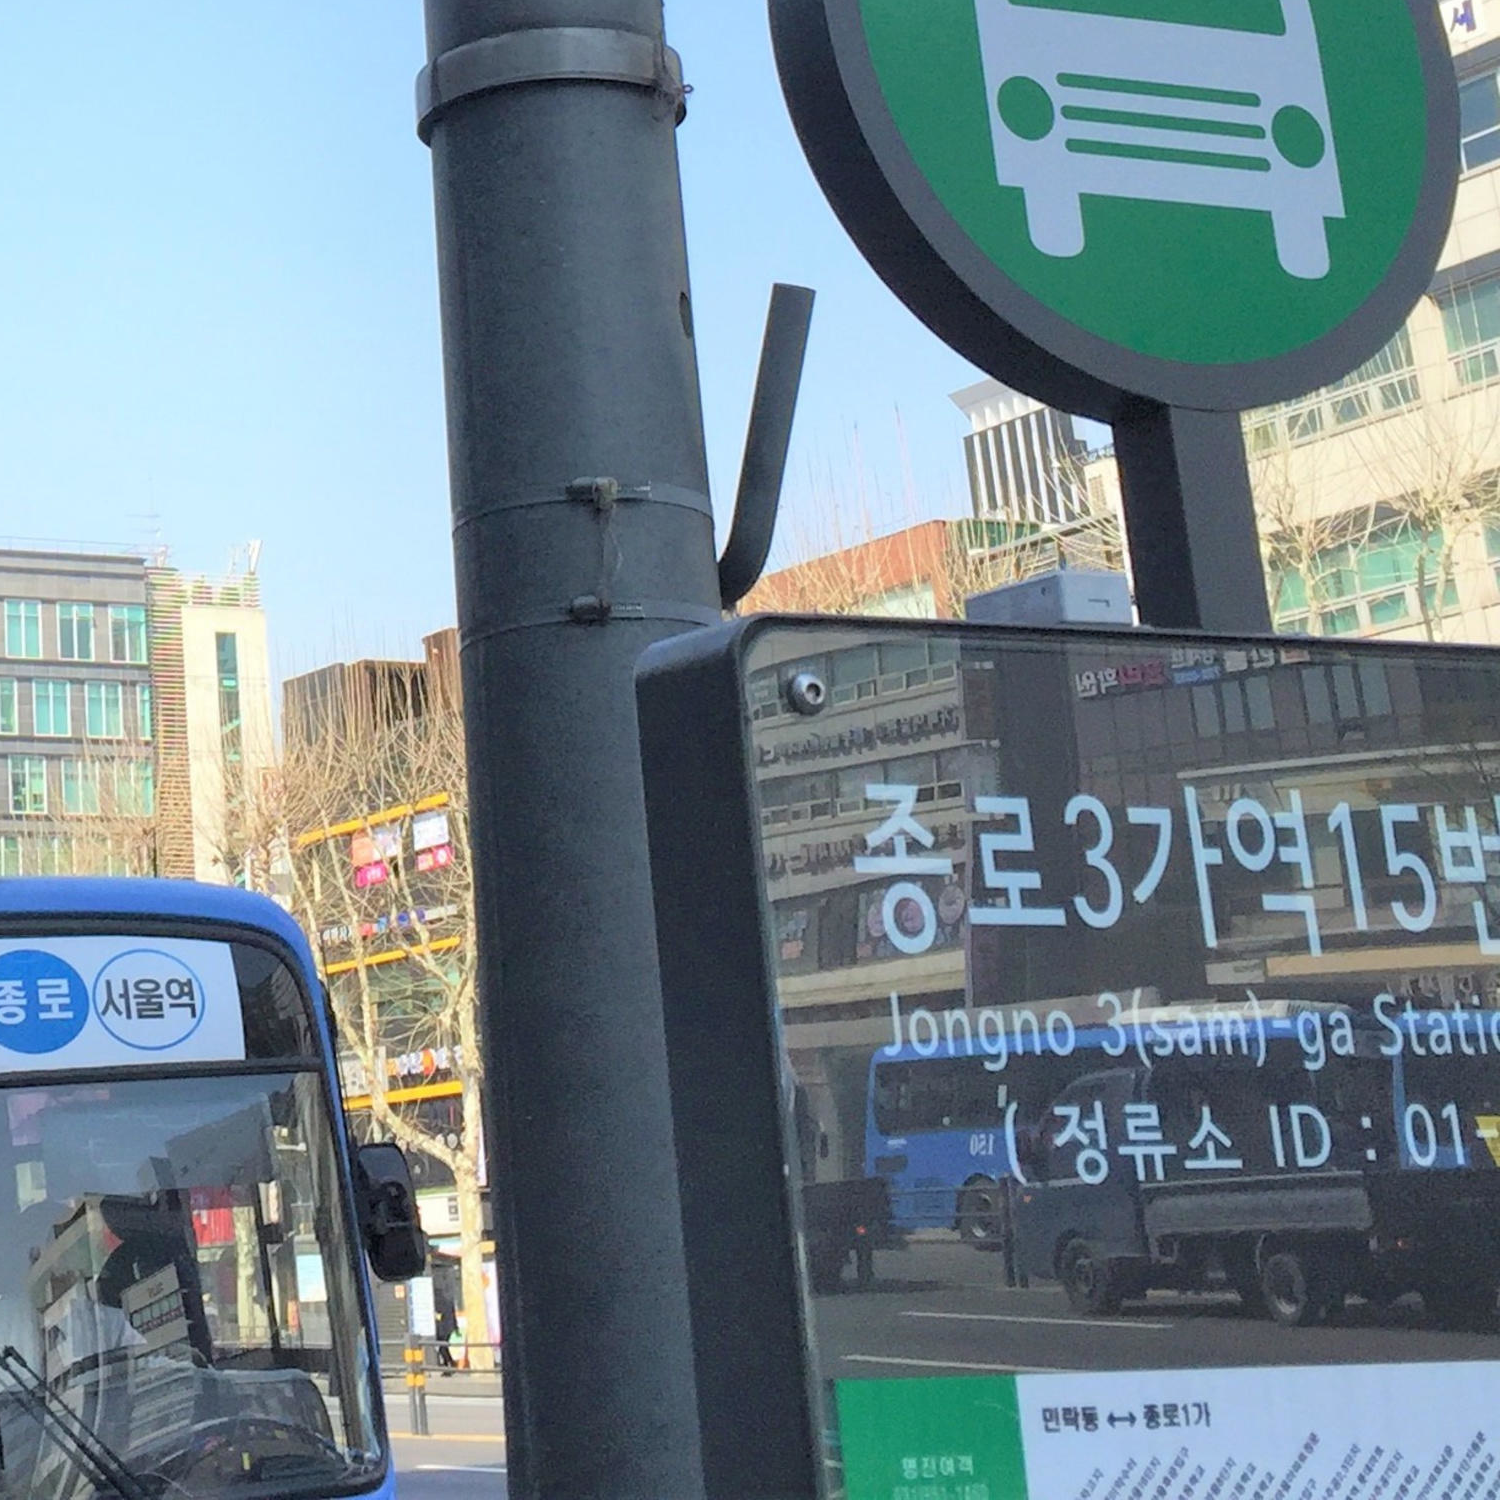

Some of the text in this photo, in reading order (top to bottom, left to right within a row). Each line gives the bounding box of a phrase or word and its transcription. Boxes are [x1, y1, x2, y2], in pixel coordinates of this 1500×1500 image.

[100, 976, 198, 1021] 서울역
[884, 991, 1076, 1070] Jongno
[1268, 1104, 1333, 1168] ID
[1142, 1402, 1211, 1430] 종로1가
